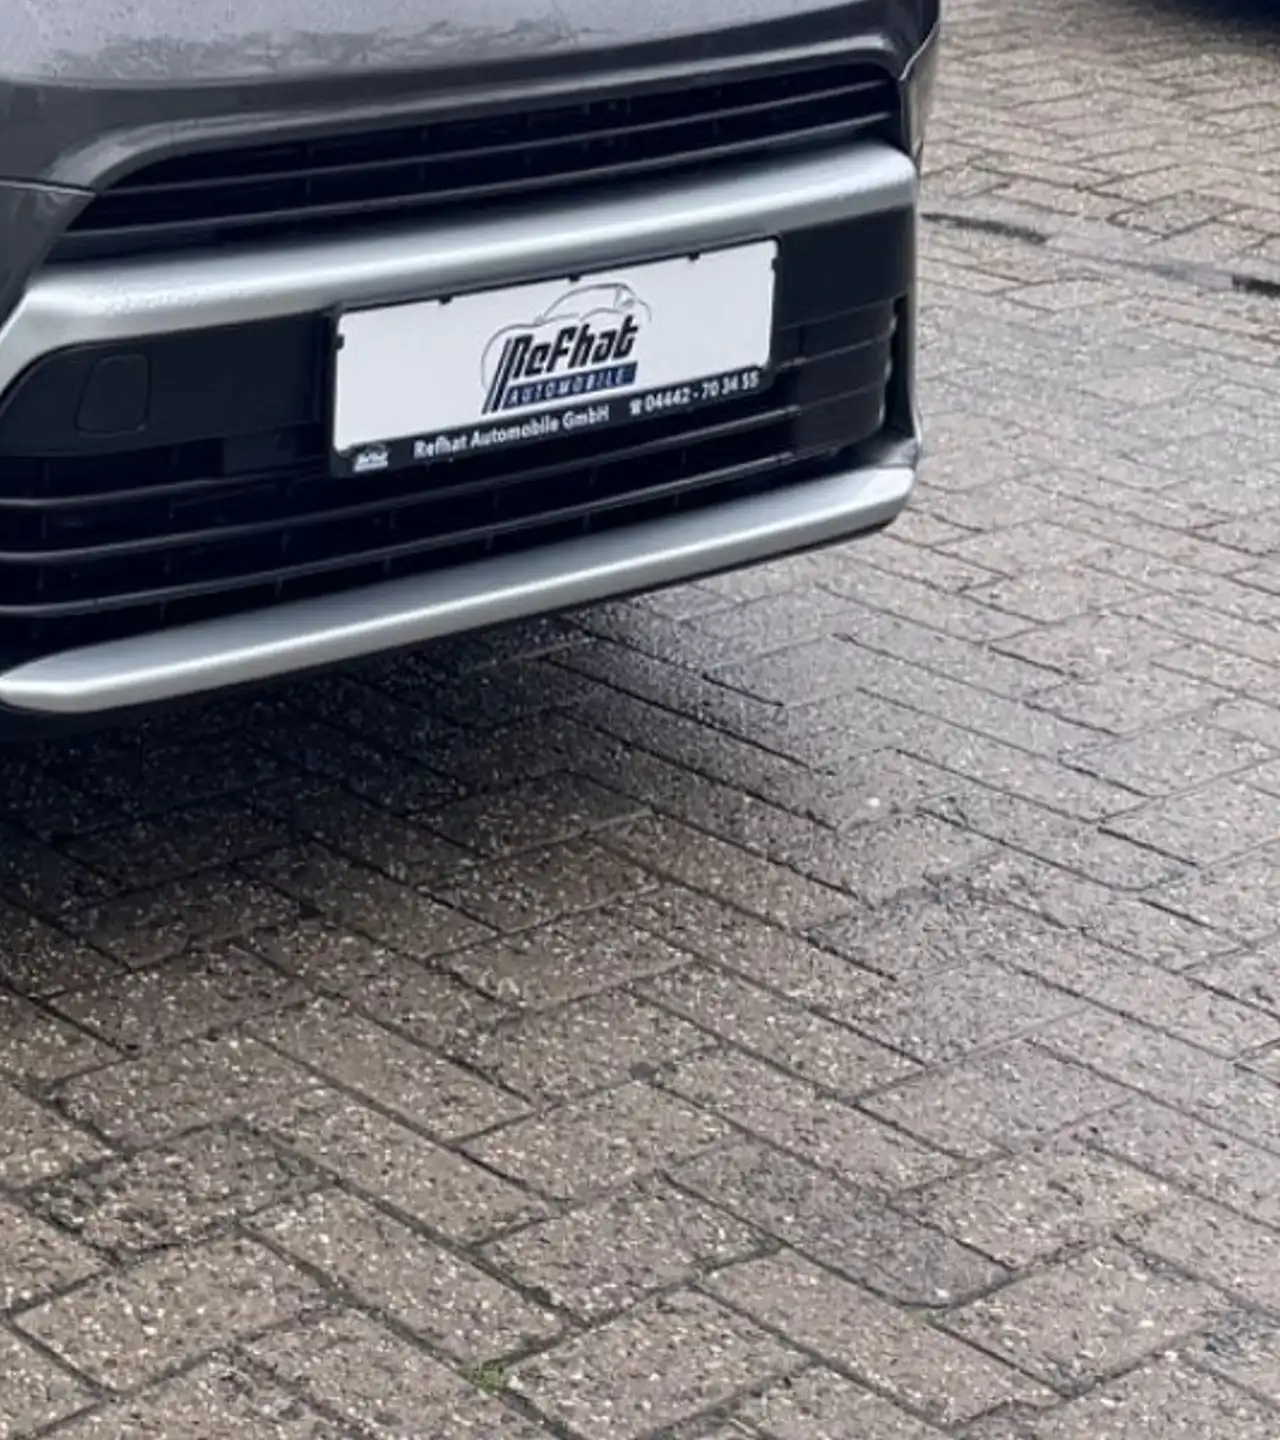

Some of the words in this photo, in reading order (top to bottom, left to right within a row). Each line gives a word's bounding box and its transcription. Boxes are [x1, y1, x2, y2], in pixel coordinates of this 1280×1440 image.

[508, 367, 625, 406] AUTOMOBILE
[413, 433, 468, 459] Refhat
[471, 413, 560, 447] Automobile
[562, 404, 610, 430] GmbH
[644, 387, 691, 413] 04442
[701, 379, 720, 401] 70
